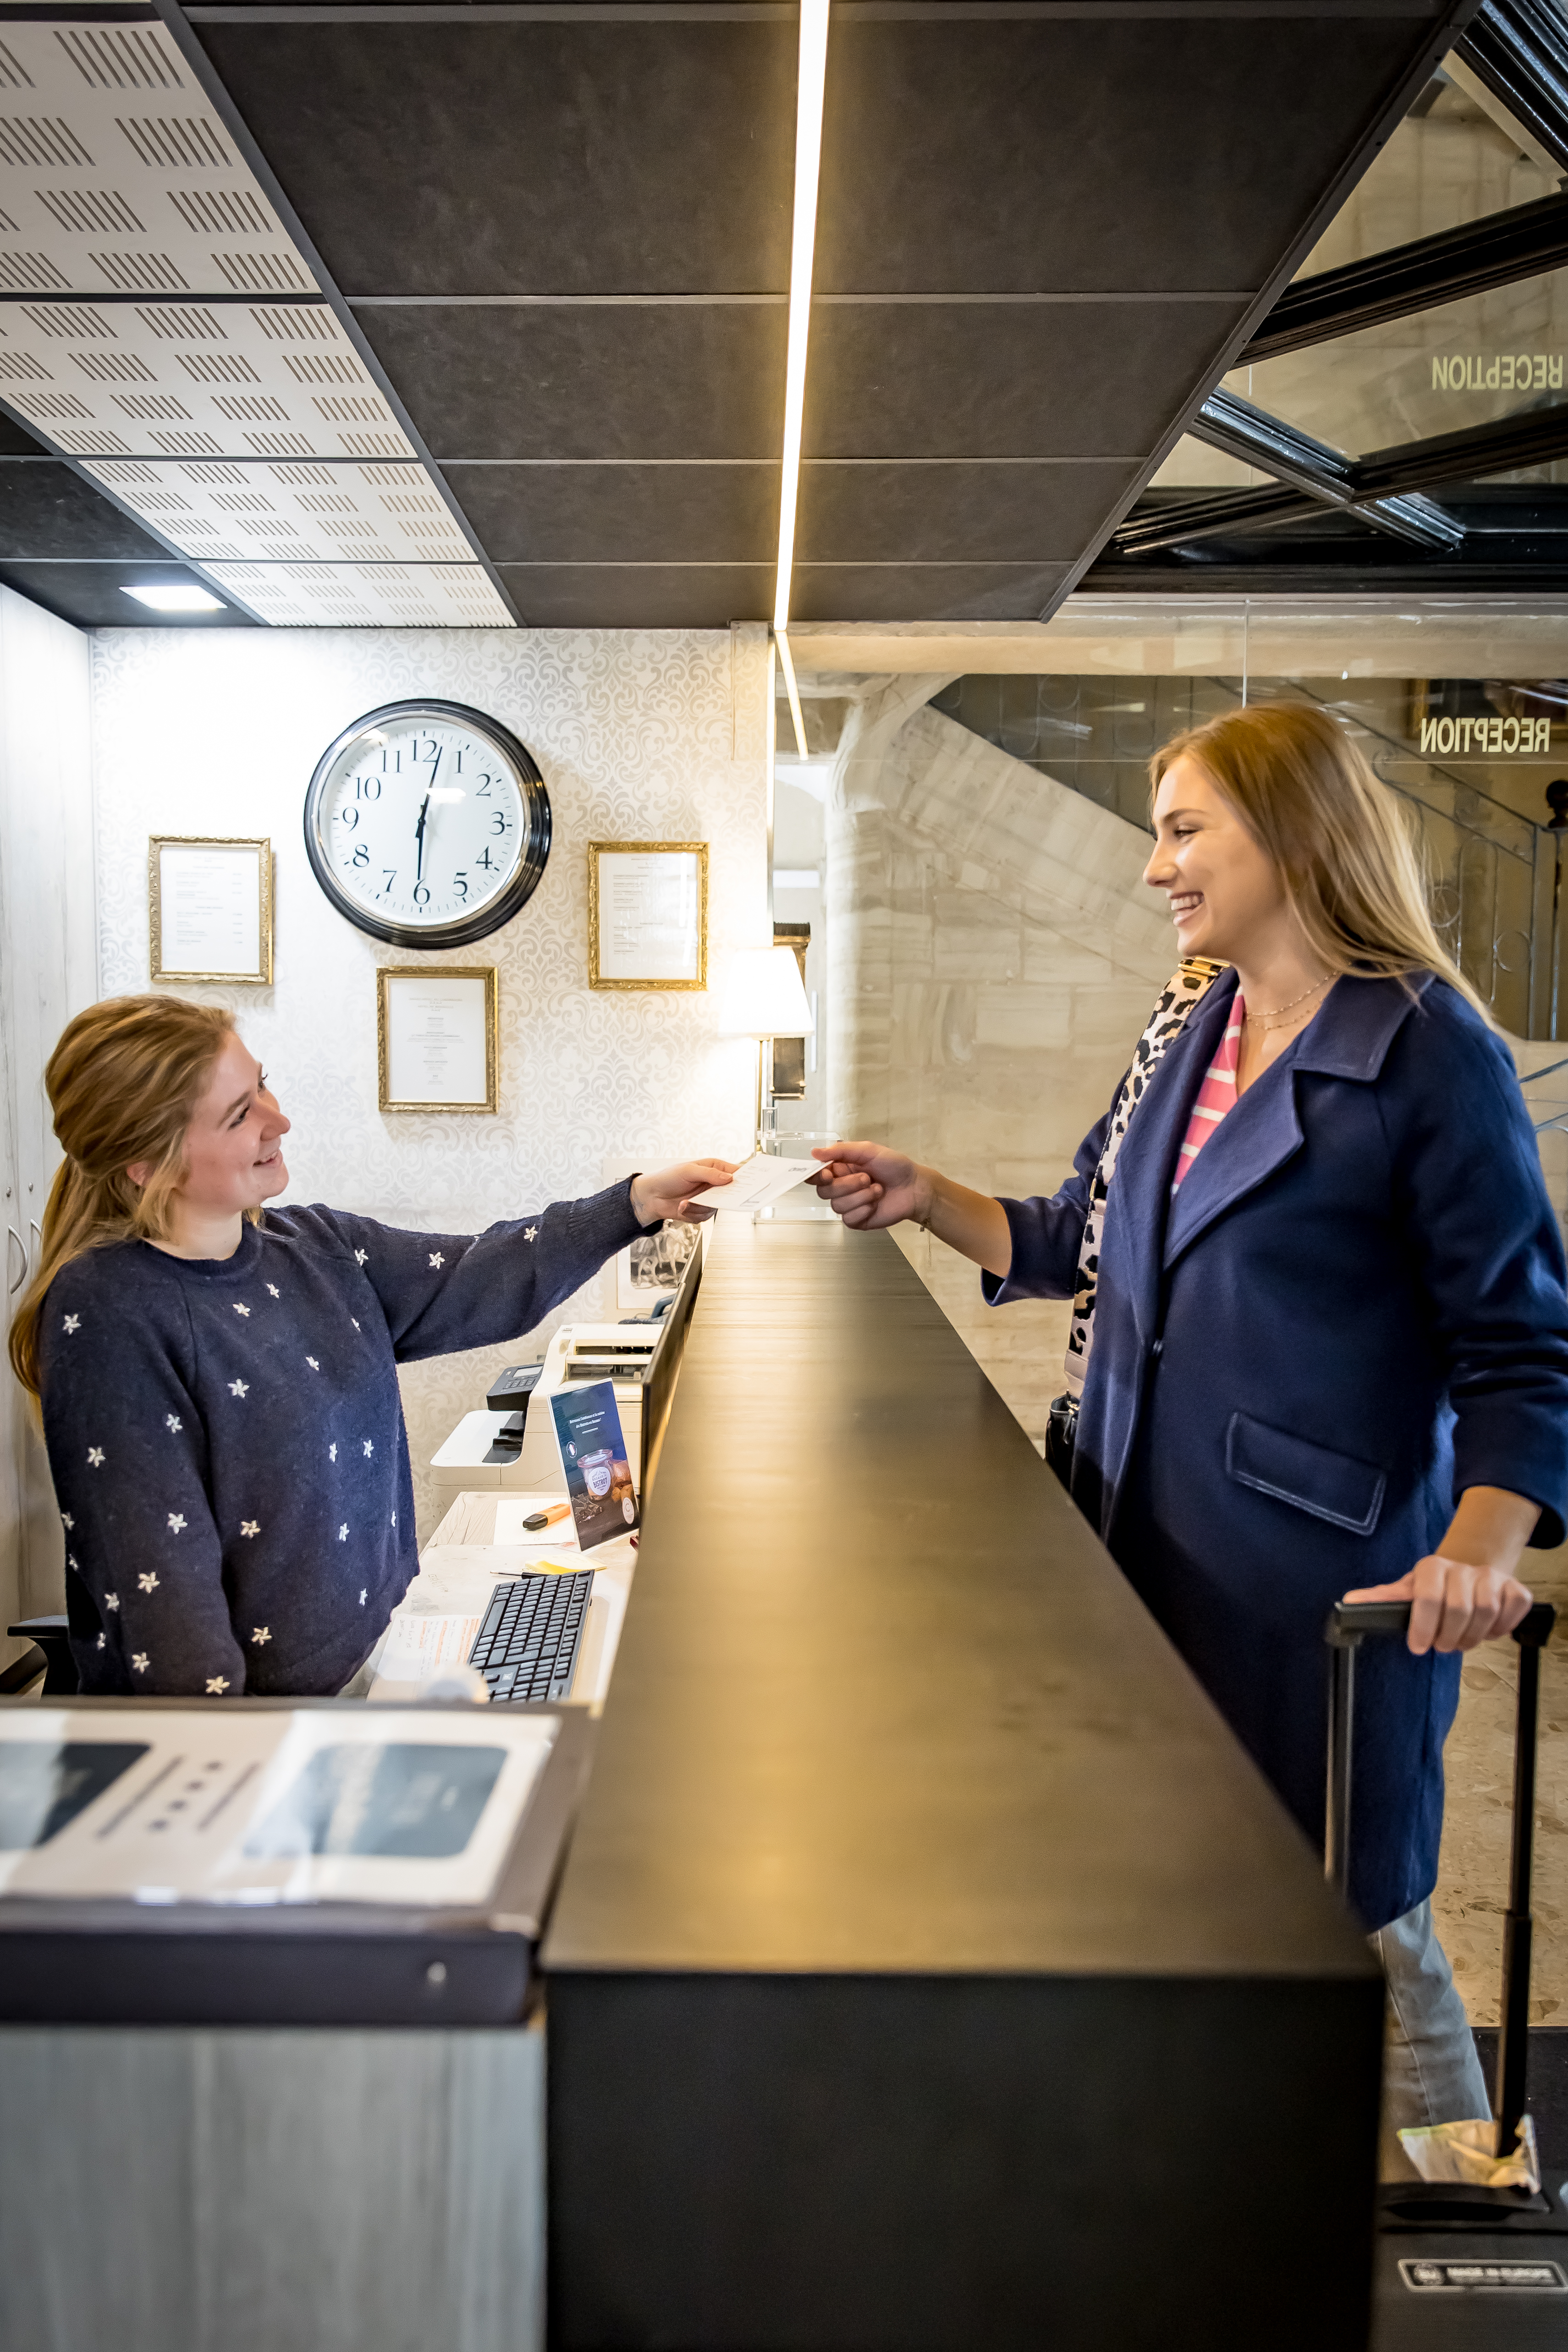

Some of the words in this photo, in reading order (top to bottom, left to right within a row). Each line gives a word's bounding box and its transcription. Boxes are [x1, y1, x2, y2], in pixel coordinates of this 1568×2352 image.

[1432, 355, 1563, 390] RECEPTION
[381, 750, 403, 774] 11
[412, 740, 439, 762] 12
[455, 750, 464, 774] 1
[355, 777, 381, 801] 10
[475, 774, 491, 797] 2
[342, 807, 359, 833] 9
[489, 811, 506, 835] 3
[352, 844, 369, 868] 8
[475, 846, 493, 871] 4
[383, 869, 397, 893] 7
[413, 879, 430, 905] 6
[453, 872, 469, 896] 5
